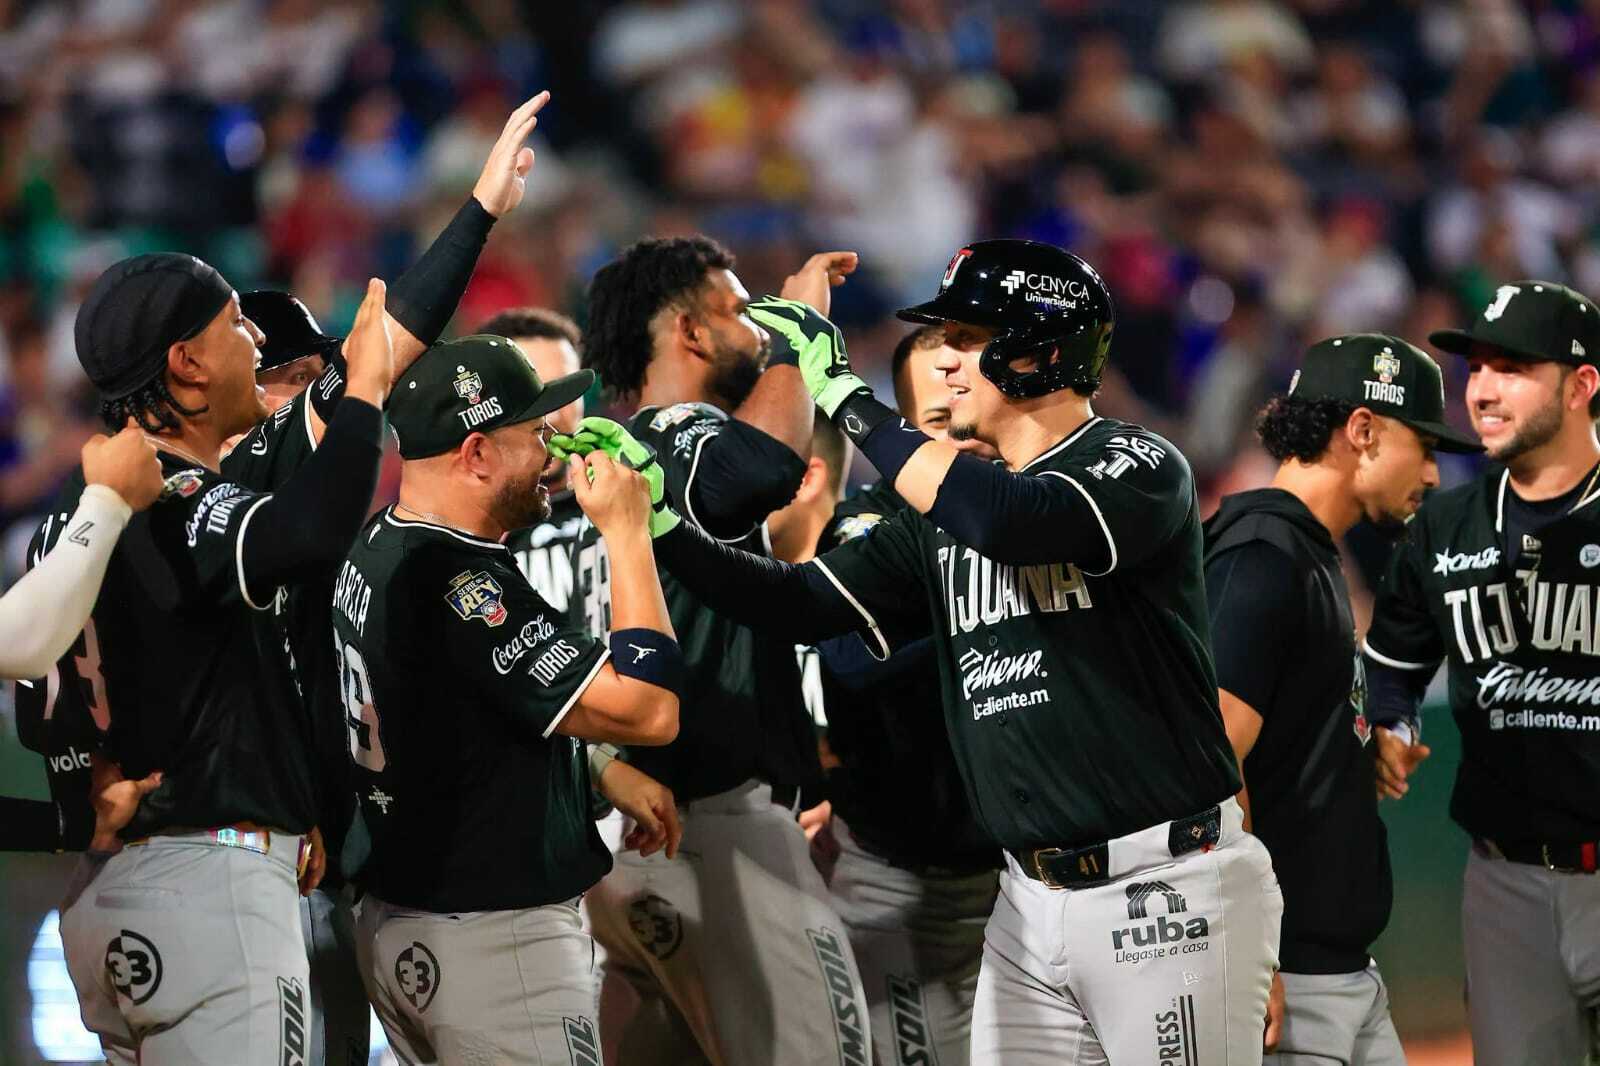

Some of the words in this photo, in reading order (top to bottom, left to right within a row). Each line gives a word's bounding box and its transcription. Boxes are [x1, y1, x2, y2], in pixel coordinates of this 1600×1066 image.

[1025, 292, 1076, 309] Universidad
[1026, 273, 1090, 300] CENYCA
[1363, 380, 1405, 406] TOROS
[457, 396, 503, 430] TOROS
[332, 559, 372, 637] ARCIA
[459, 580, 501, 616] REY
[528, 639, 580, 687] TOROS
[1112, 916, 1209, 950] ruba
[1115, 947, 1165, 964] Llegaste
[1169, 946, 1178, 956] a
[1182, 941, 1209, 954] casa
